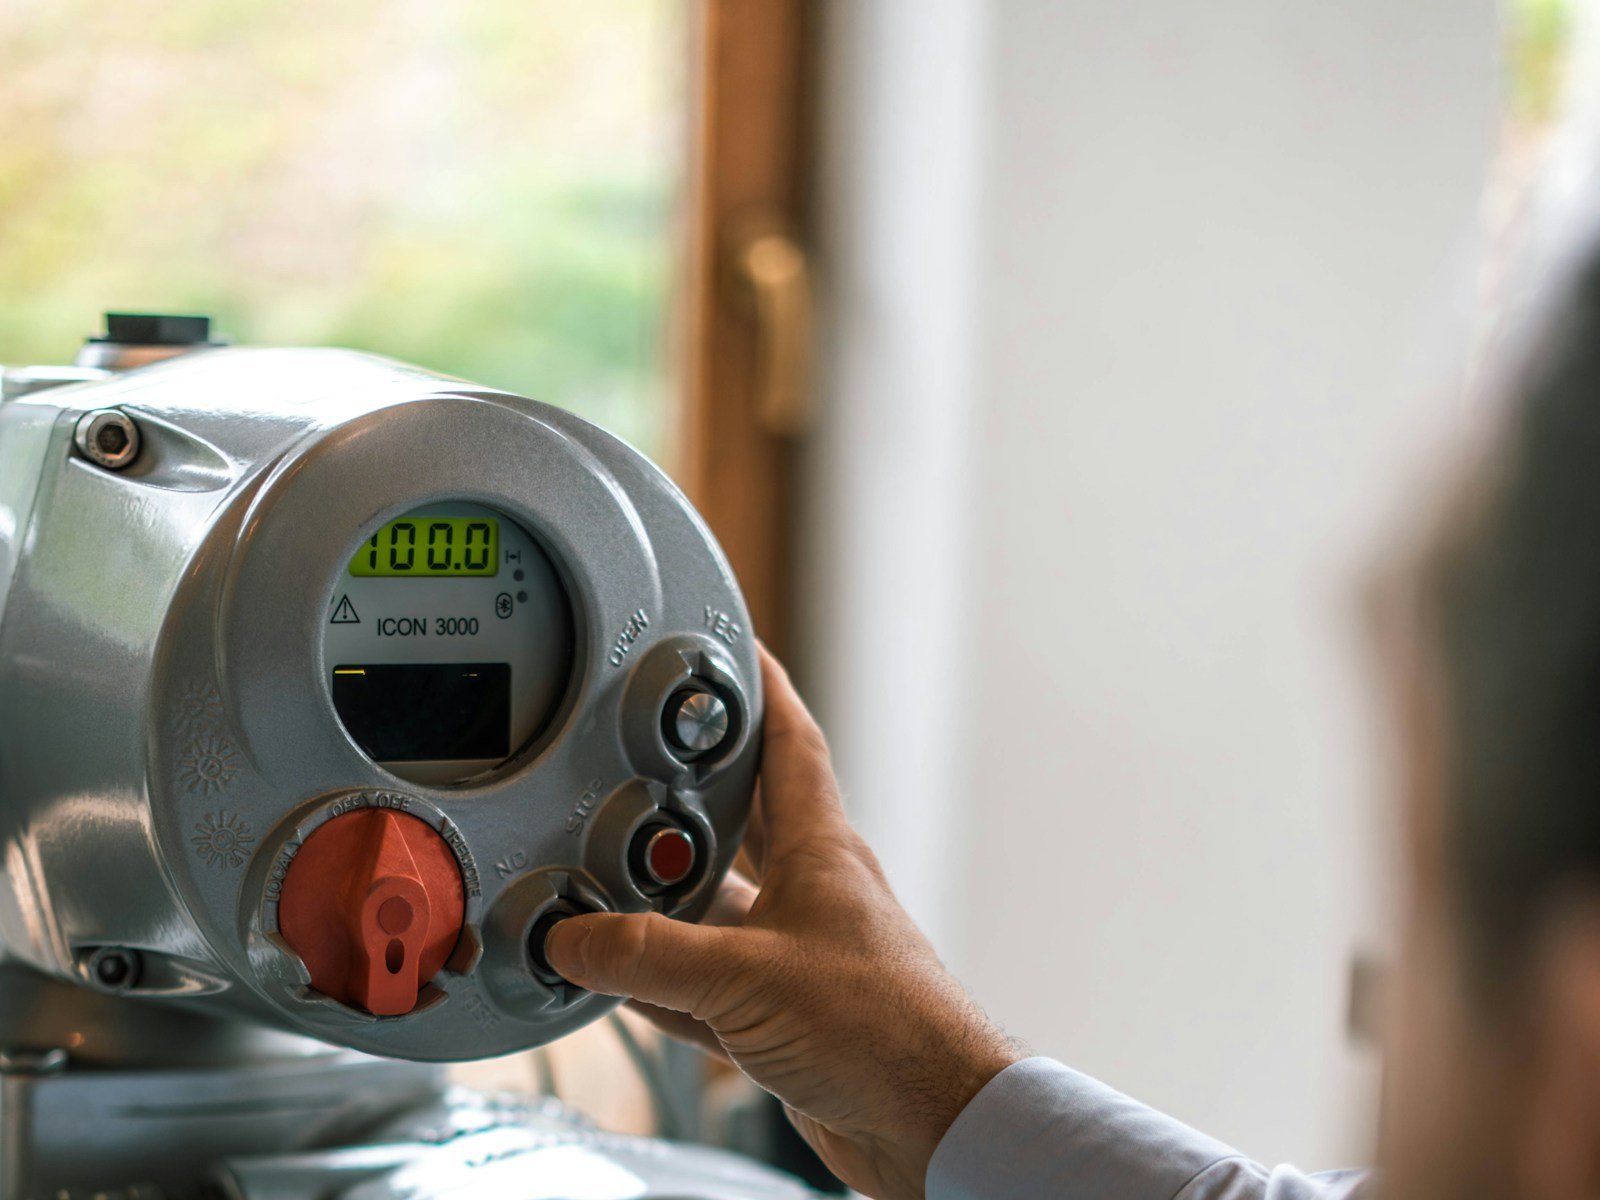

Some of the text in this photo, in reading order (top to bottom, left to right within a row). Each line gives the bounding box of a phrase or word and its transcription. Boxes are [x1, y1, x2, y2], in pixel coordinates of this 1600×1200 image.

[369, 522, 491, 570] 100.0
[377, 617, 480, 636] ICON 3000
[609, 608, 649, 667] OPEN
[704, 604, 741, 645] YES
[376, 791, 410, 812] OFF
[565, 776, 603, 837] STOP
[495, 851, 527, 880] NO
